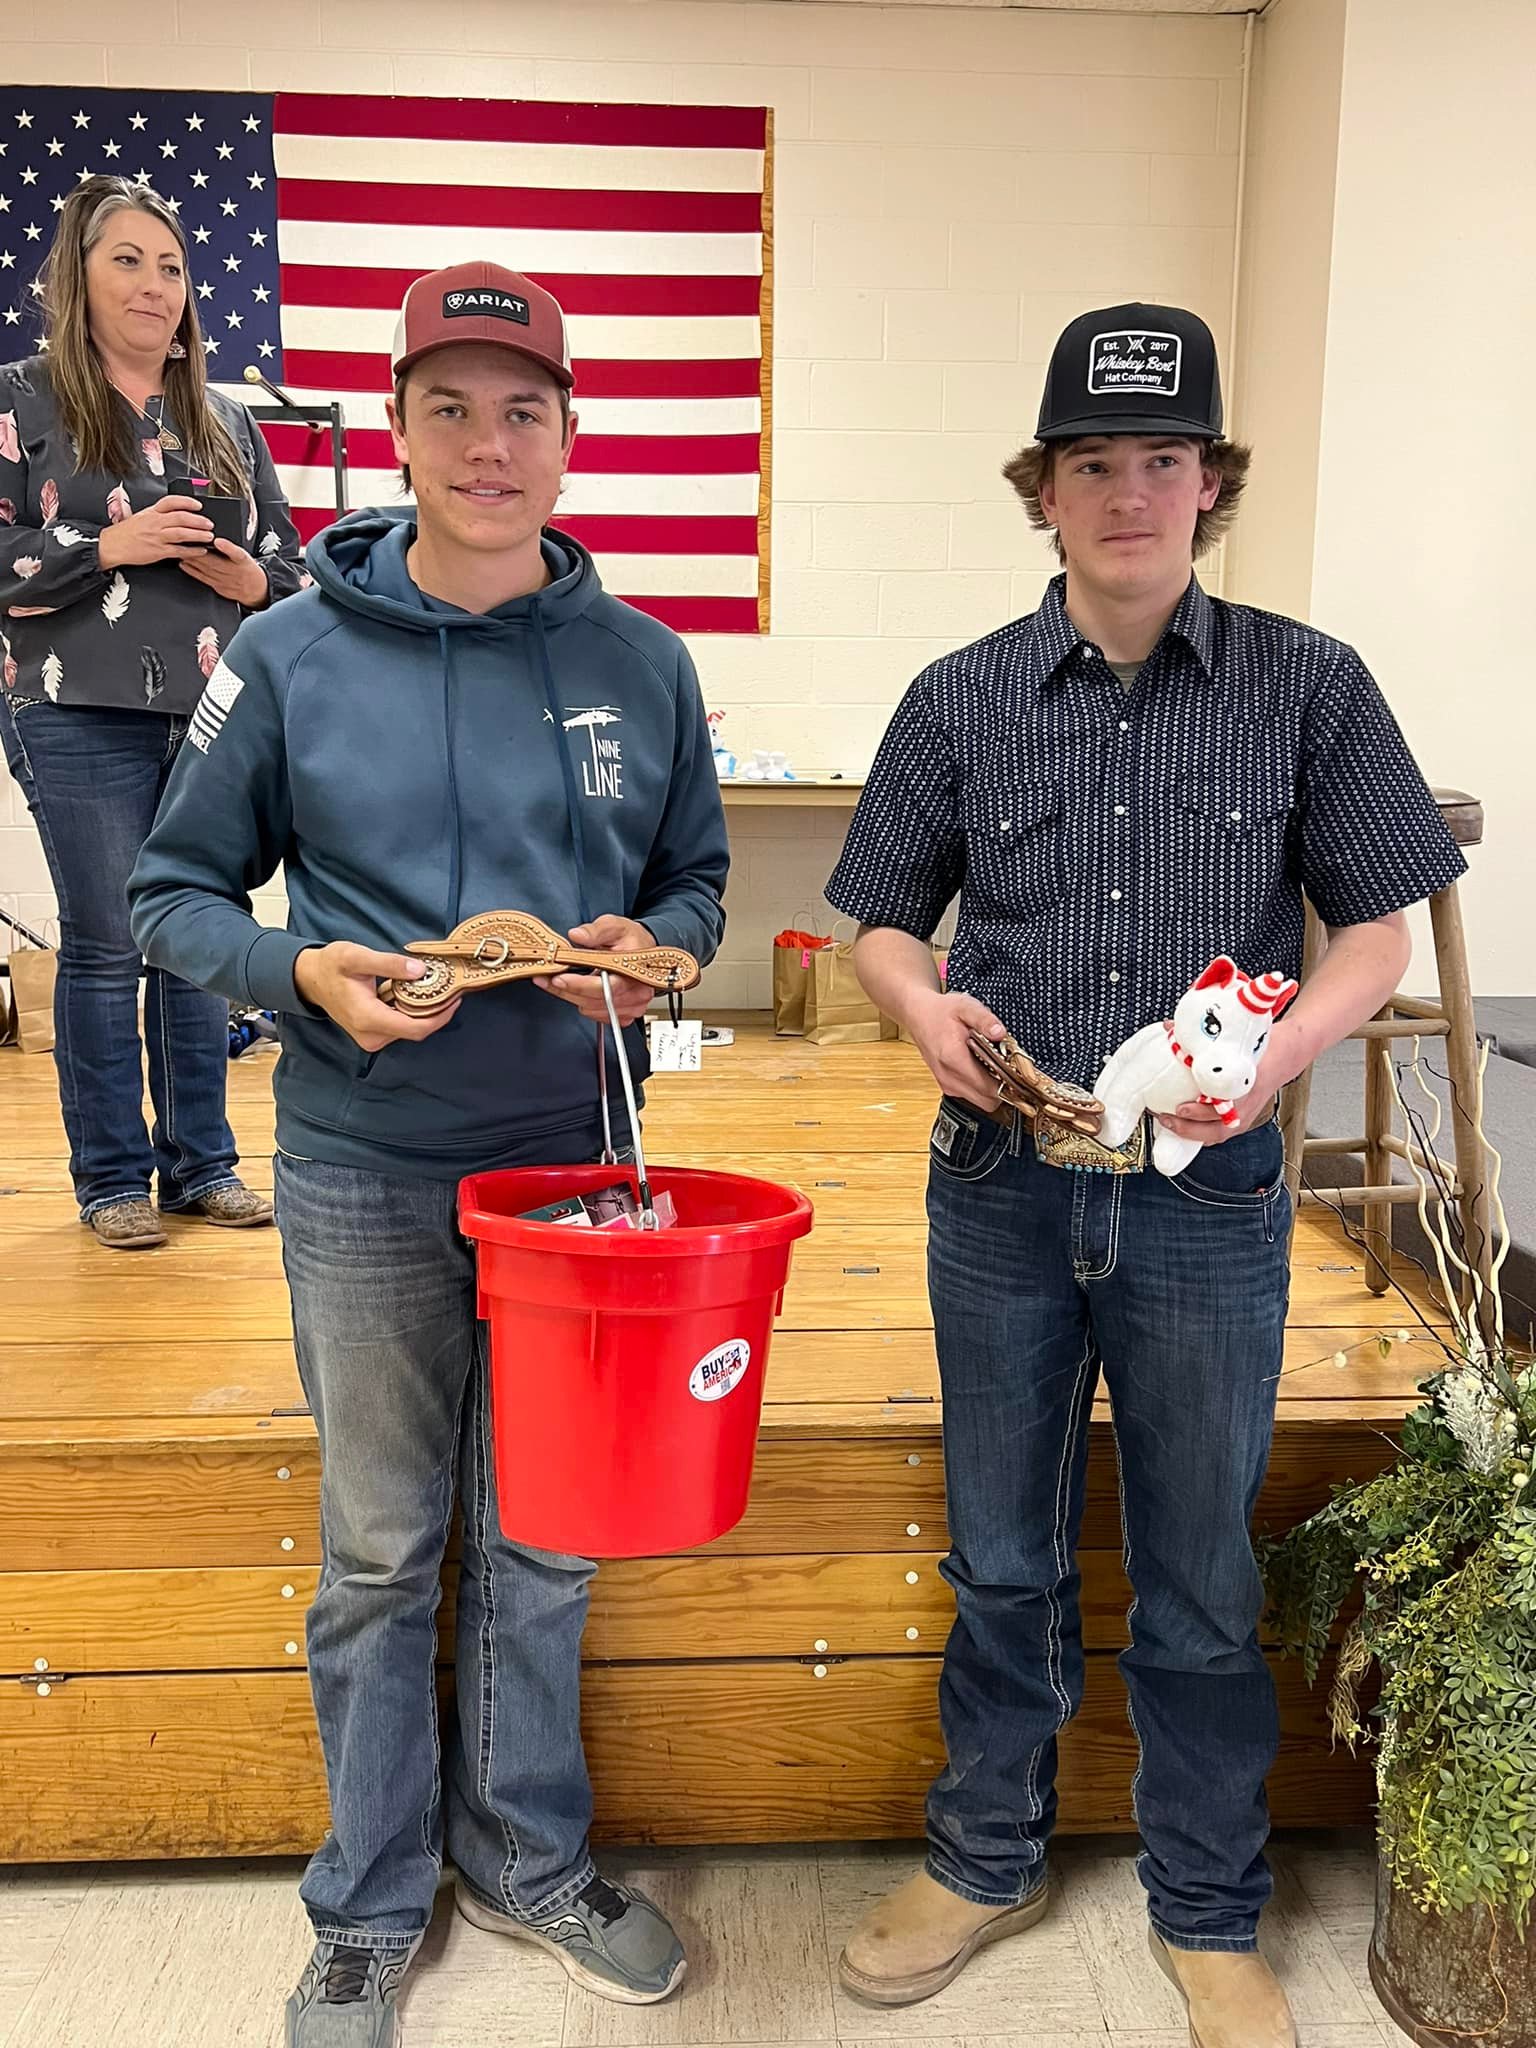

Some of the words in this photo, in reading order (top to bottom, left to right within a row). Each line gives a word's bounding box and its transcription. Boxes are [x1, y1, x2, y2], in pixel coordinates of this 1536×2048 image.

[465, 294, 525, 313] ARIAT
[1103, 341, 1120, 351] Est.
[1149, 341, 1170, 351] 2017
[1095, 354, 1145, 374] Whiskey
[1145, 356, 1176, 372] Bent
[1105, 373, 1121, 383] Hat
[1121, 372, 1163, 385] Company
[596, 738, 622, 760] NINE
[582, 760, 624, 799] LINE
[701, 1355, 724, 1380] BUY
